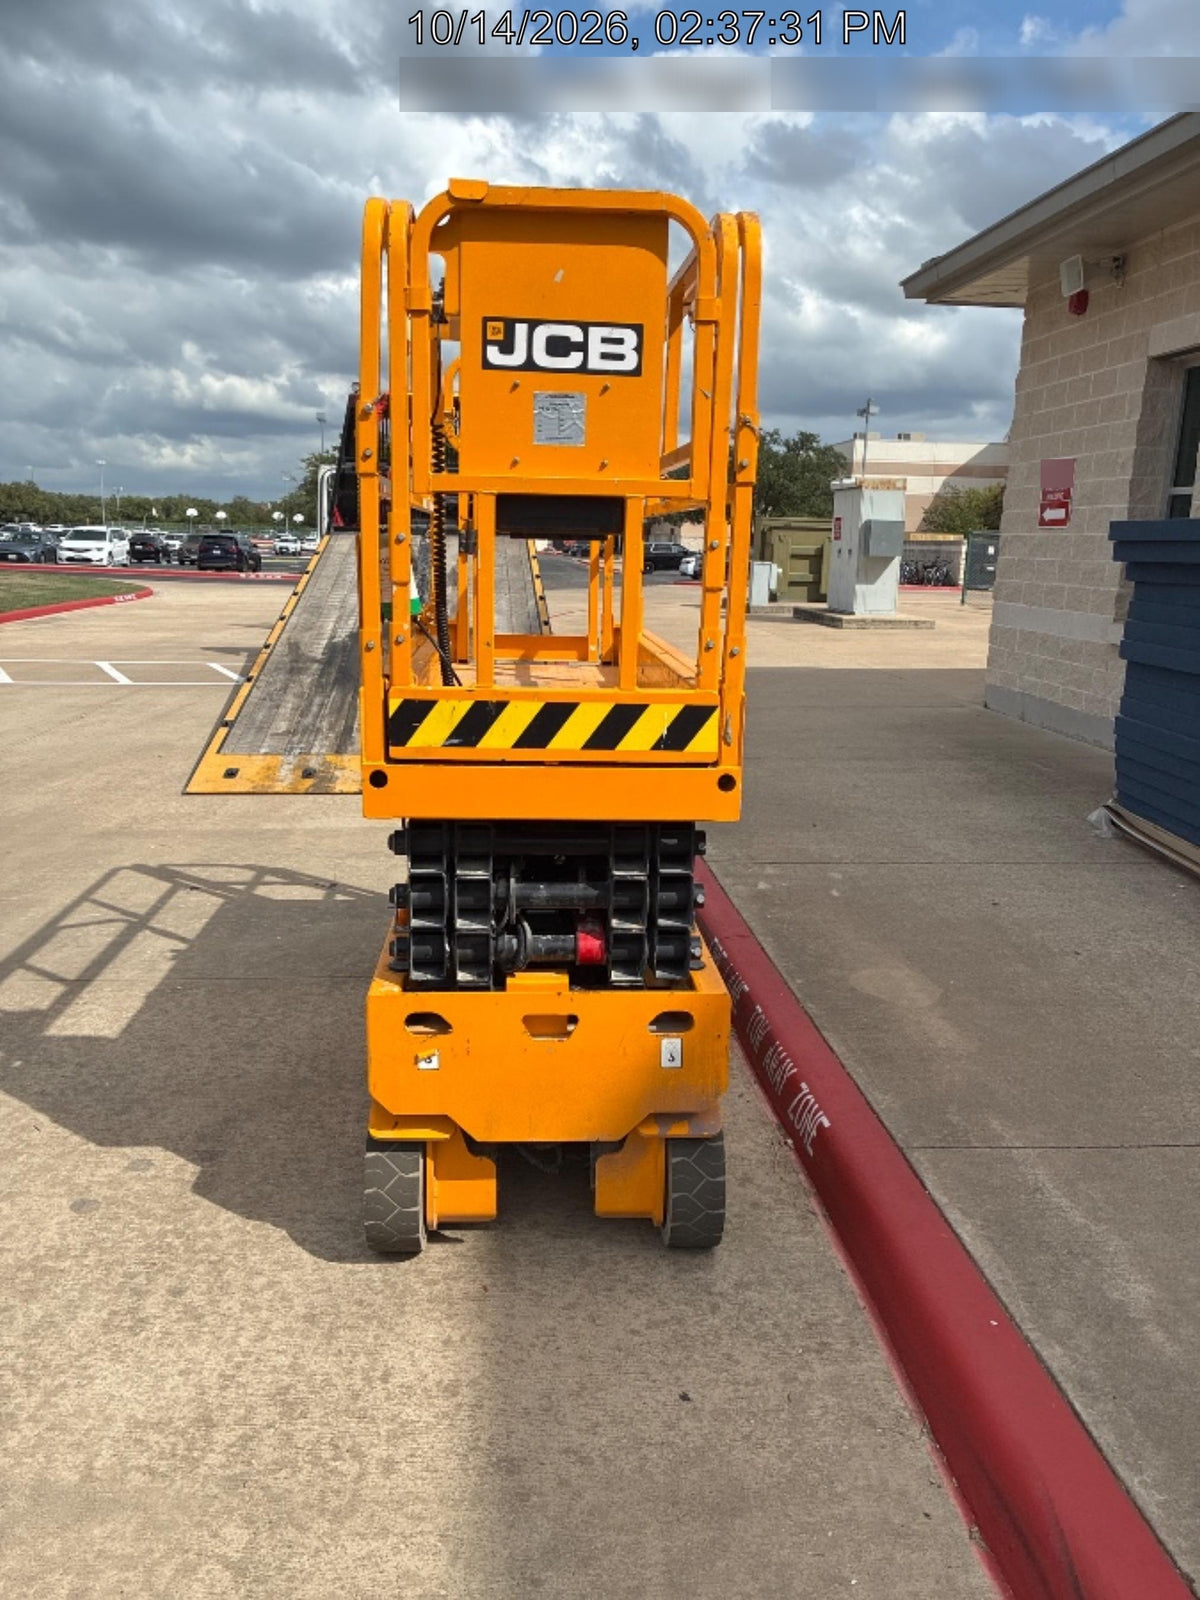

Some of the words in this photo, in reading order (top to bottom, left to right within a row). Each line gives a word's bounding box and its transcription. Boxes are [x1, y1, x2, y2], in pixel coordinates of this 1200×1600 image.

[486, 323, 640, 371] JCB
[762, 1040, 798, 1096] AWAY
[787, 1082, 831, 1157] ZONE
